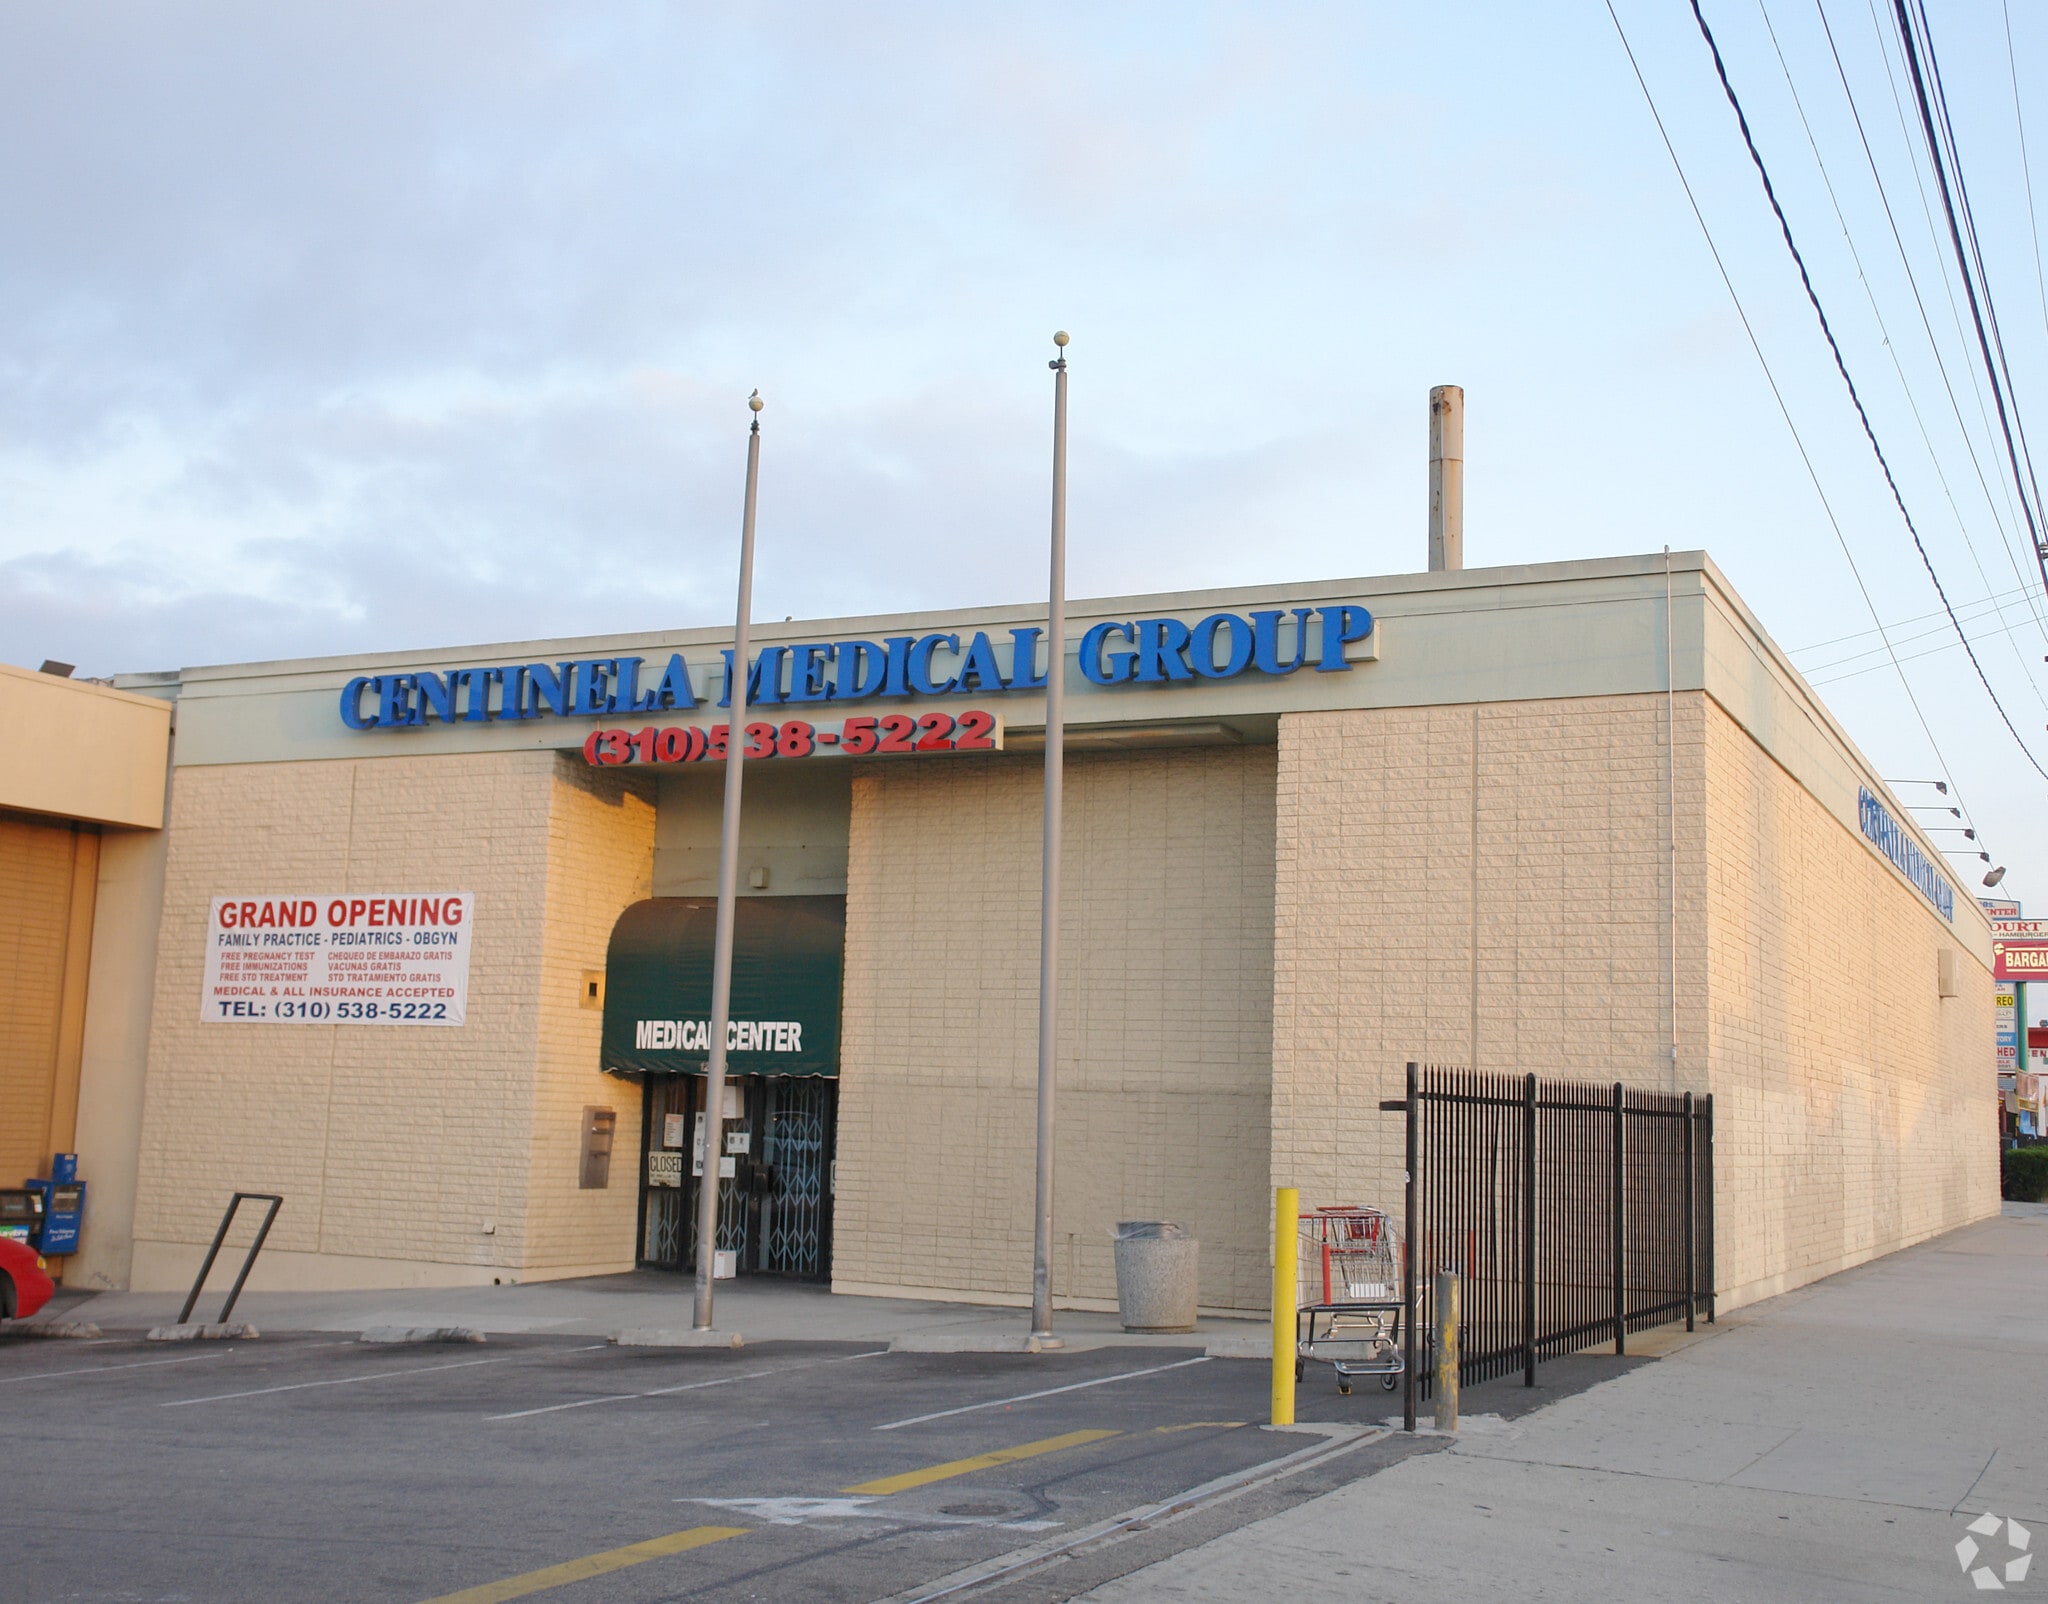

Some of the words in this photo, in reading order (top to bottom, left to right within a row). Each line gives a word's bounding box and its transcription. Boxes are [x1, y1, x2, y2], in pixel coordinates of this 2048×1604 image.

[340, 653, 698, 730] CENTINELA
[717, 627, 1048, 707] MEDICAL
[1079, 605, 1374, 685] GROUP
[219, 901, 317, 928] GRAND
[328, 898, 463, 927] OPENING
[1986, 908, 2017, 916] NTER
[218, 933, 260, 946] FAMILY
[263, 933, 321, 946] PRACTICE
[331, 932, 402, 945] PEDIATRICS
[414, 931, 458, 945] OBGYN
[221, 952, 240, 960] FREE
[243, 952, 292, 960] PREGNANCY
[295, 951, 315, 960] TEST
[328, 951, 364, 960] CHEQUEO
[367, 951, 376, 960] DE
[379, 951, 421, 960] EMBARAZO
[423, 951, 453, 960] GRATIS
[220, 962, 240, 971] FREE
[243, 962, 308, 971] IMMUNIZATIONS
[328, 962, 368, 971] VACUNAS
[370, 962, 401, 971] GRATIS
[220, 973, 240, 981] FREE
[242, 973, 257, 981] STD
[260, 973, 308, 981] TREATMENT
[328, 973, 344, 982] STD
[347, 973, 407, 982] TRATAMIENTO
[409, 973, 441, 982] GRATIS
[213, 986, 266, 996] MEDICAL
[270, 986, 278, 996] &
[283, 987, 305, 996] ALL
[309, 987, 382, 997] INSURANCE
[386, 987, 455, 997] ACCEPTED
[218, 1001, 266, 1017] TEL:
[275, 1002, 330, 1019] (310)
[337, 1003, 446, 1019] 538-5222
[726, 1021, 802, 1052] CENTER
[650, 1155, 682, 1173] CLOSED
